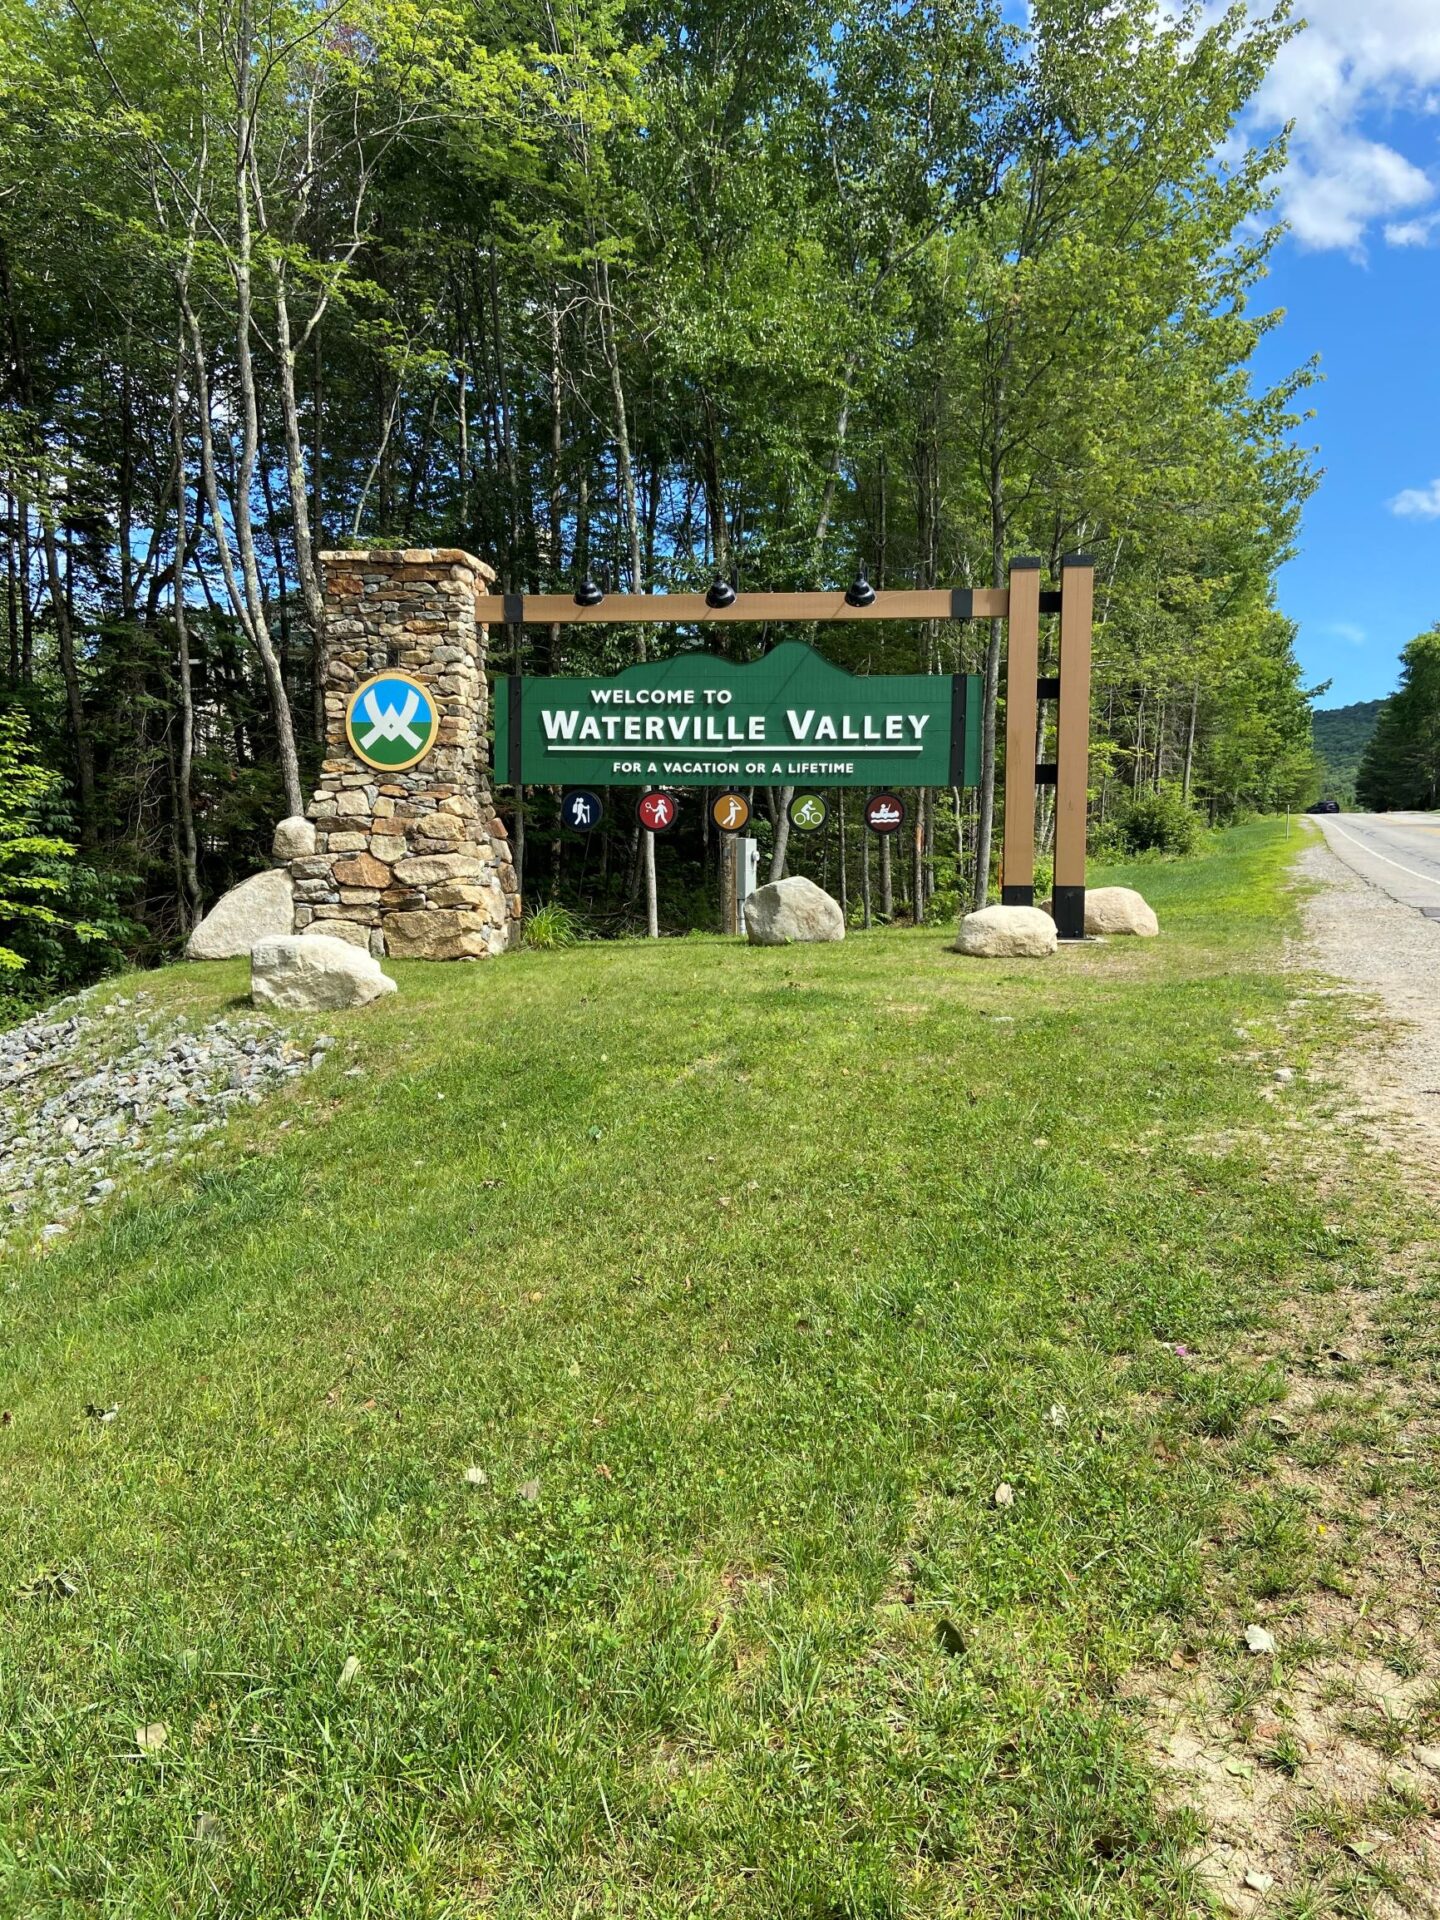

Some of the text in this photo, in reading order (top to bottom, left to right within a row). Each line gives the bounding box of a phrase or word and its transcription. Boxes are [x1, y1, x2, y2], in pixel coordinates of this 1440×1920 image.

[591, 689, 732, 704] WELCOME TO
[541, 709, 930, 740] WATERVILLE VALLEY
[613, 762, 854, 774] FOR A VACATION OR A LIFETIME
